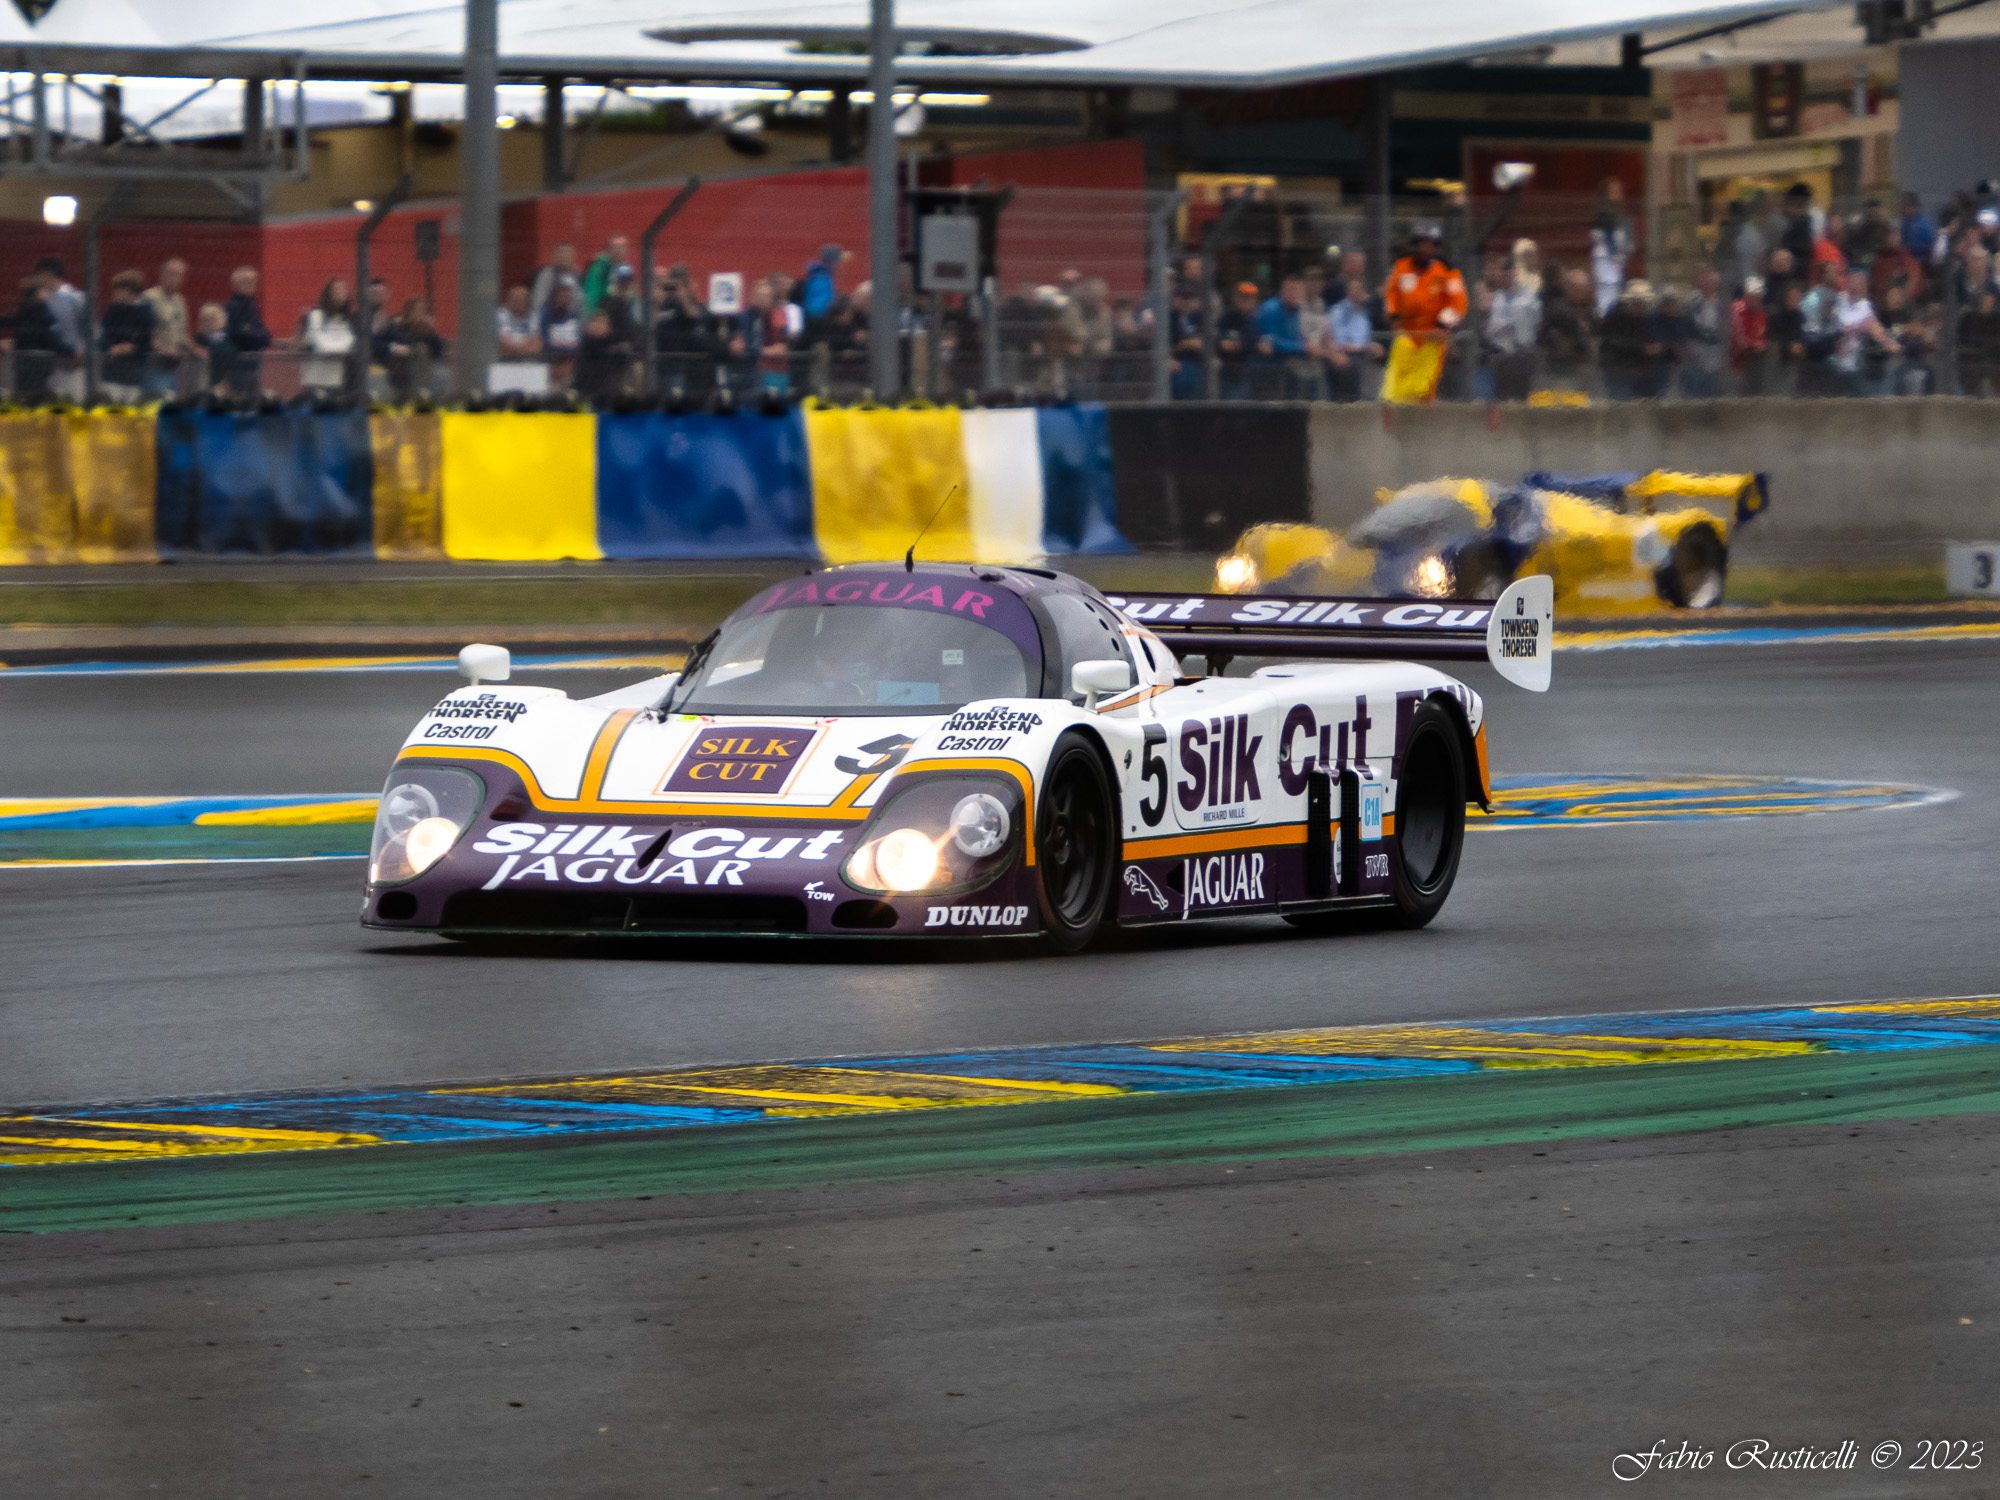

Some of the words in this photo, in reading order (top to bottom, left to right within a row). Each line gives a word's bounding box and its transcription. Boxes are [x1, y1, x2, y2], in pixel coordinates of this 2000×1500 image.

[1973, 551, 1992, 589] 3
[756, 581, 994, 618] JAGUAR
[1231, 601, 1376, 624] Silk
[1382, 604, 1489, 626] Cu
[1501, 619, 1539, 638] TOWNSEND
[1502, 639, 1537, 658] THORESEN
[424, 723, 498, 739] Castrol
[937, 735, 1012, 751] Castrol
[696, 738, 798, 757] SILK
[1177, 714, 1263, 812] Silk
[1279, 695, 1372, 797] Cut
[688, 762, 777, 781] CUT
[1139, 723, 1168, 827] 5
[1203, 811, 1227, 822] RICHARD
[1228, 807, 1246, 819] MILLE
[1364, 797, 1380, 827] C1A
[472, 822, 655, 856] Silk
[667, 828, 844, 860] Cut
[481, 854, 751, 890] JAGUAR
[1365, 853, 1389, 878] TWR
[1182, 853, 1265, 920] JAGUAR
[924, 905, 1029, 926] DUNLOP
